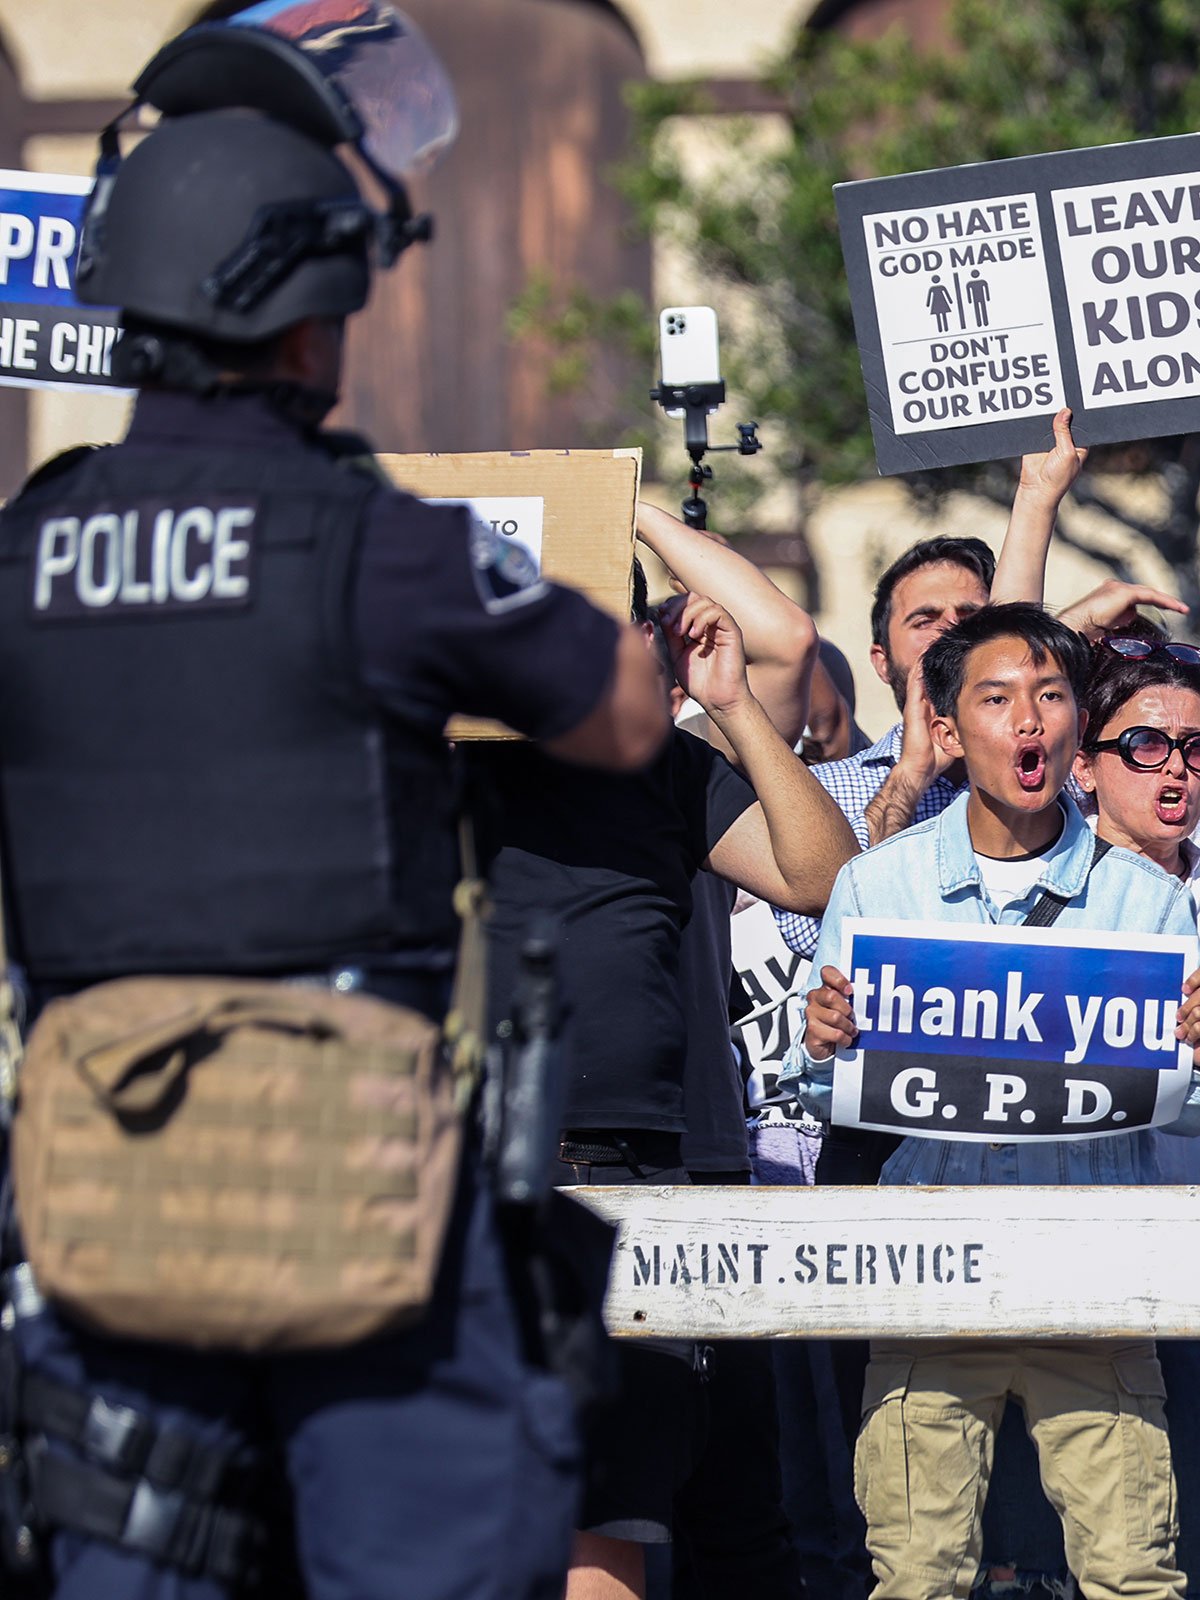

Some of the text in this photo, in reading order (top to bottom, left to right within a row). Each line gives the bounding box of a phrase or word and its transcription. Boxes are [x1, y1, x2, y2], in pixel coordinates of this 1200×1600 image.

[874, 202, 1030, 248] NO HATE
[879, 237, 1035, 277] GOD MADE
[930, 334, 1009, 362] DON'T
[899, 354, 1050, 394] CONFUSE
[903, 383, 1053, 423] OUR KIDS
[490, 520, 518, 536] TO
[34, 506, 254, 610] POLICE
[852, 964, 1044, 1043] thank
[1064, 994, 1179, 1064] you
[890, 1067, 1128, 1123] G. P. D.
